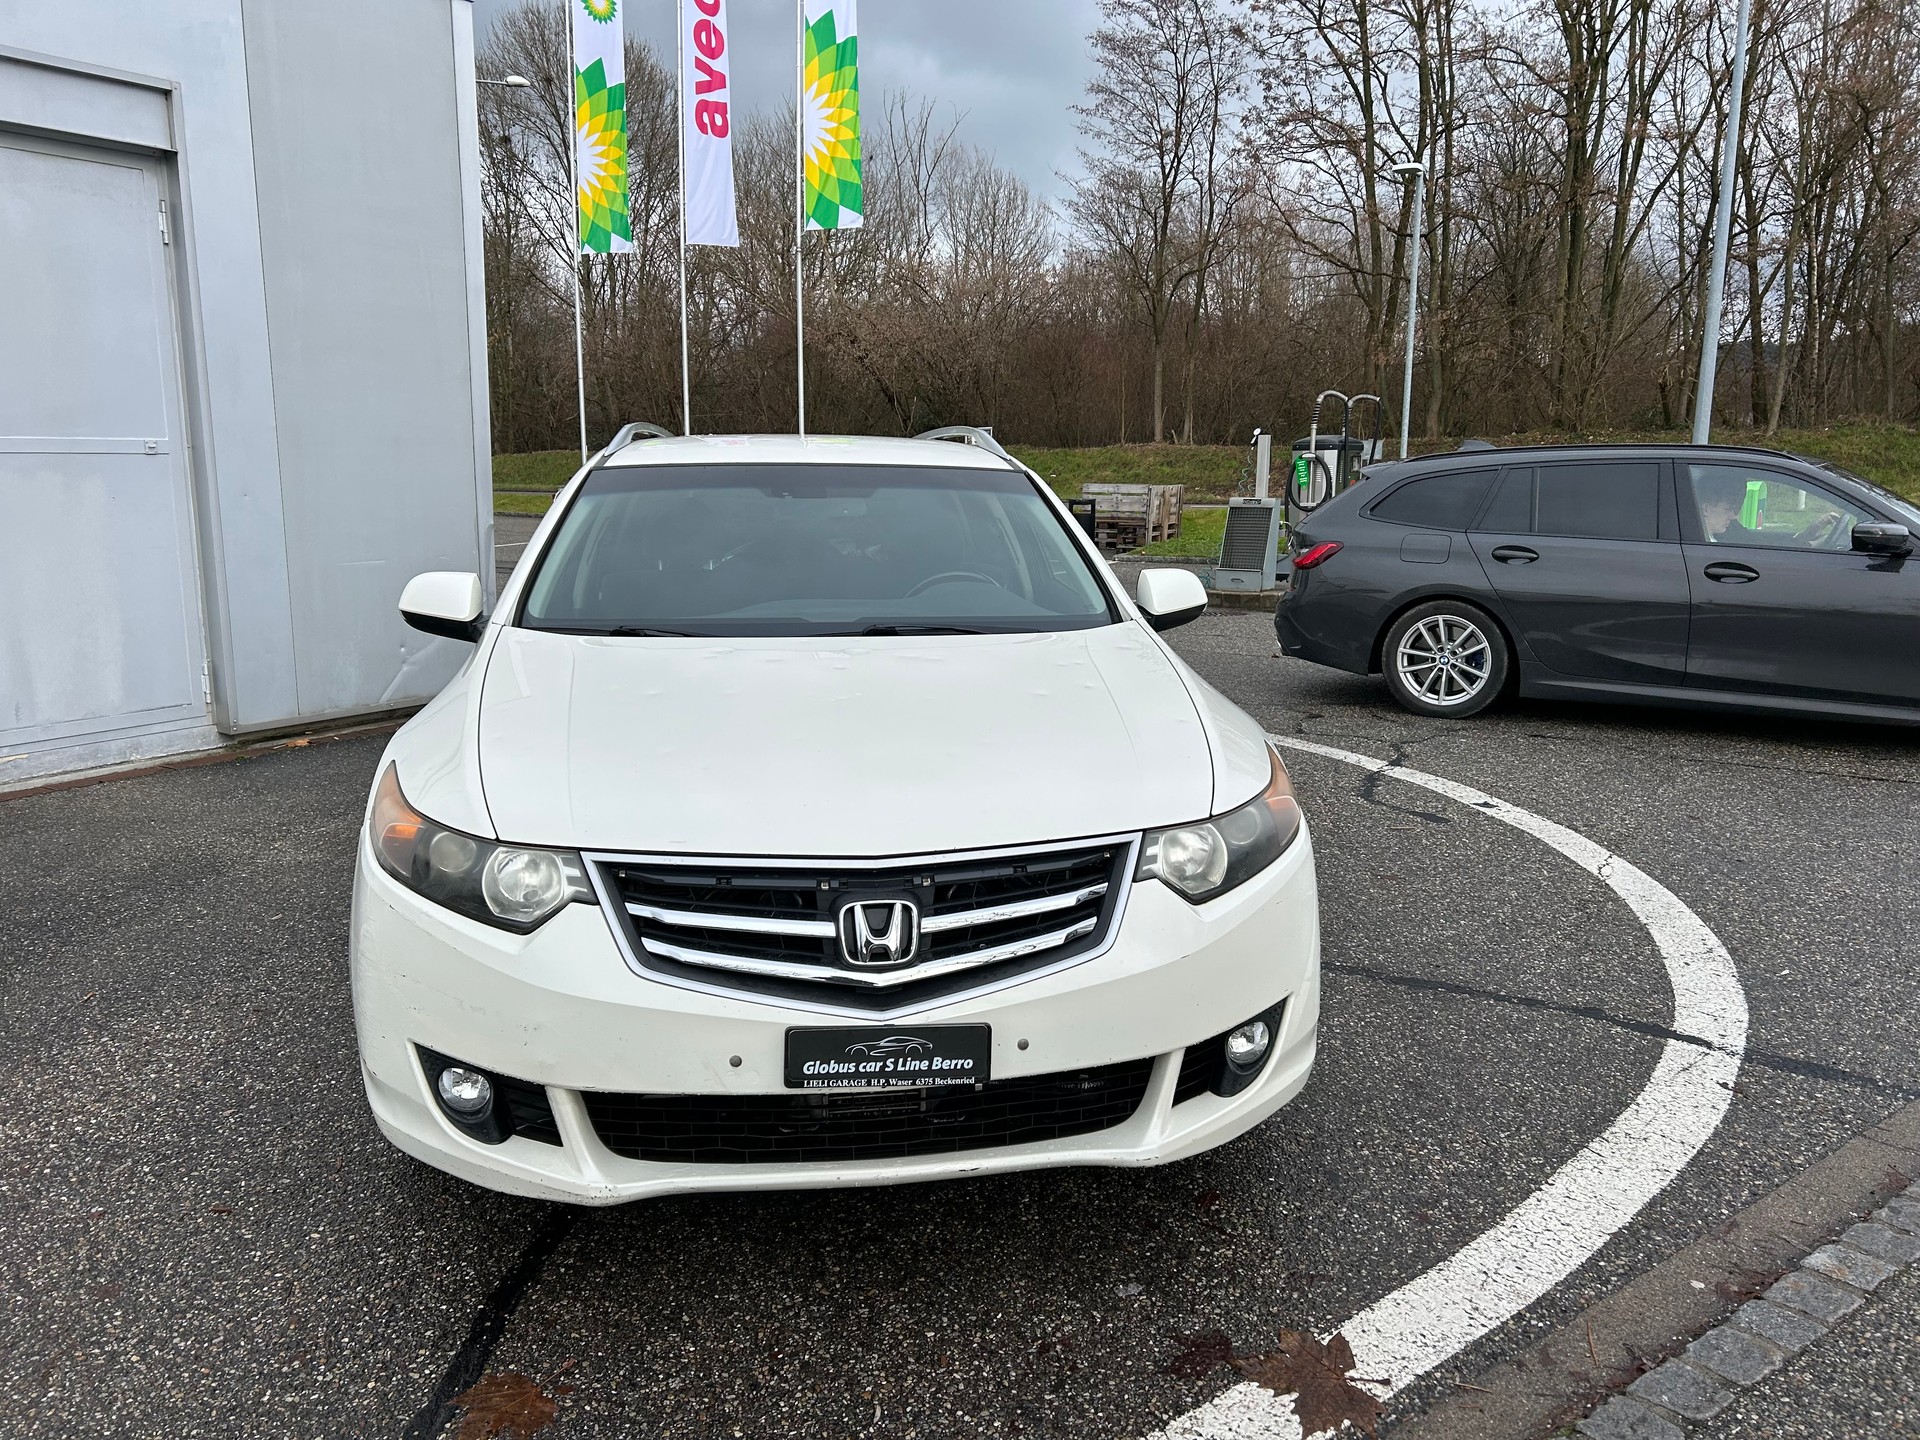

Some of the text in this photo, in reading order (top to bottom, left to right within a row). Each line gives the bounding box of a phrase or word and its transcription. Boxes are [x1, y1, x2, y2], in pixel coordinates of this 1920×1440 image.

[802, 1056, 974, 1075] Globus car S Line Berro
[803, 1076, 975, 1088] LIELI GARAGE H.P. Waser 6375 Beckenried
